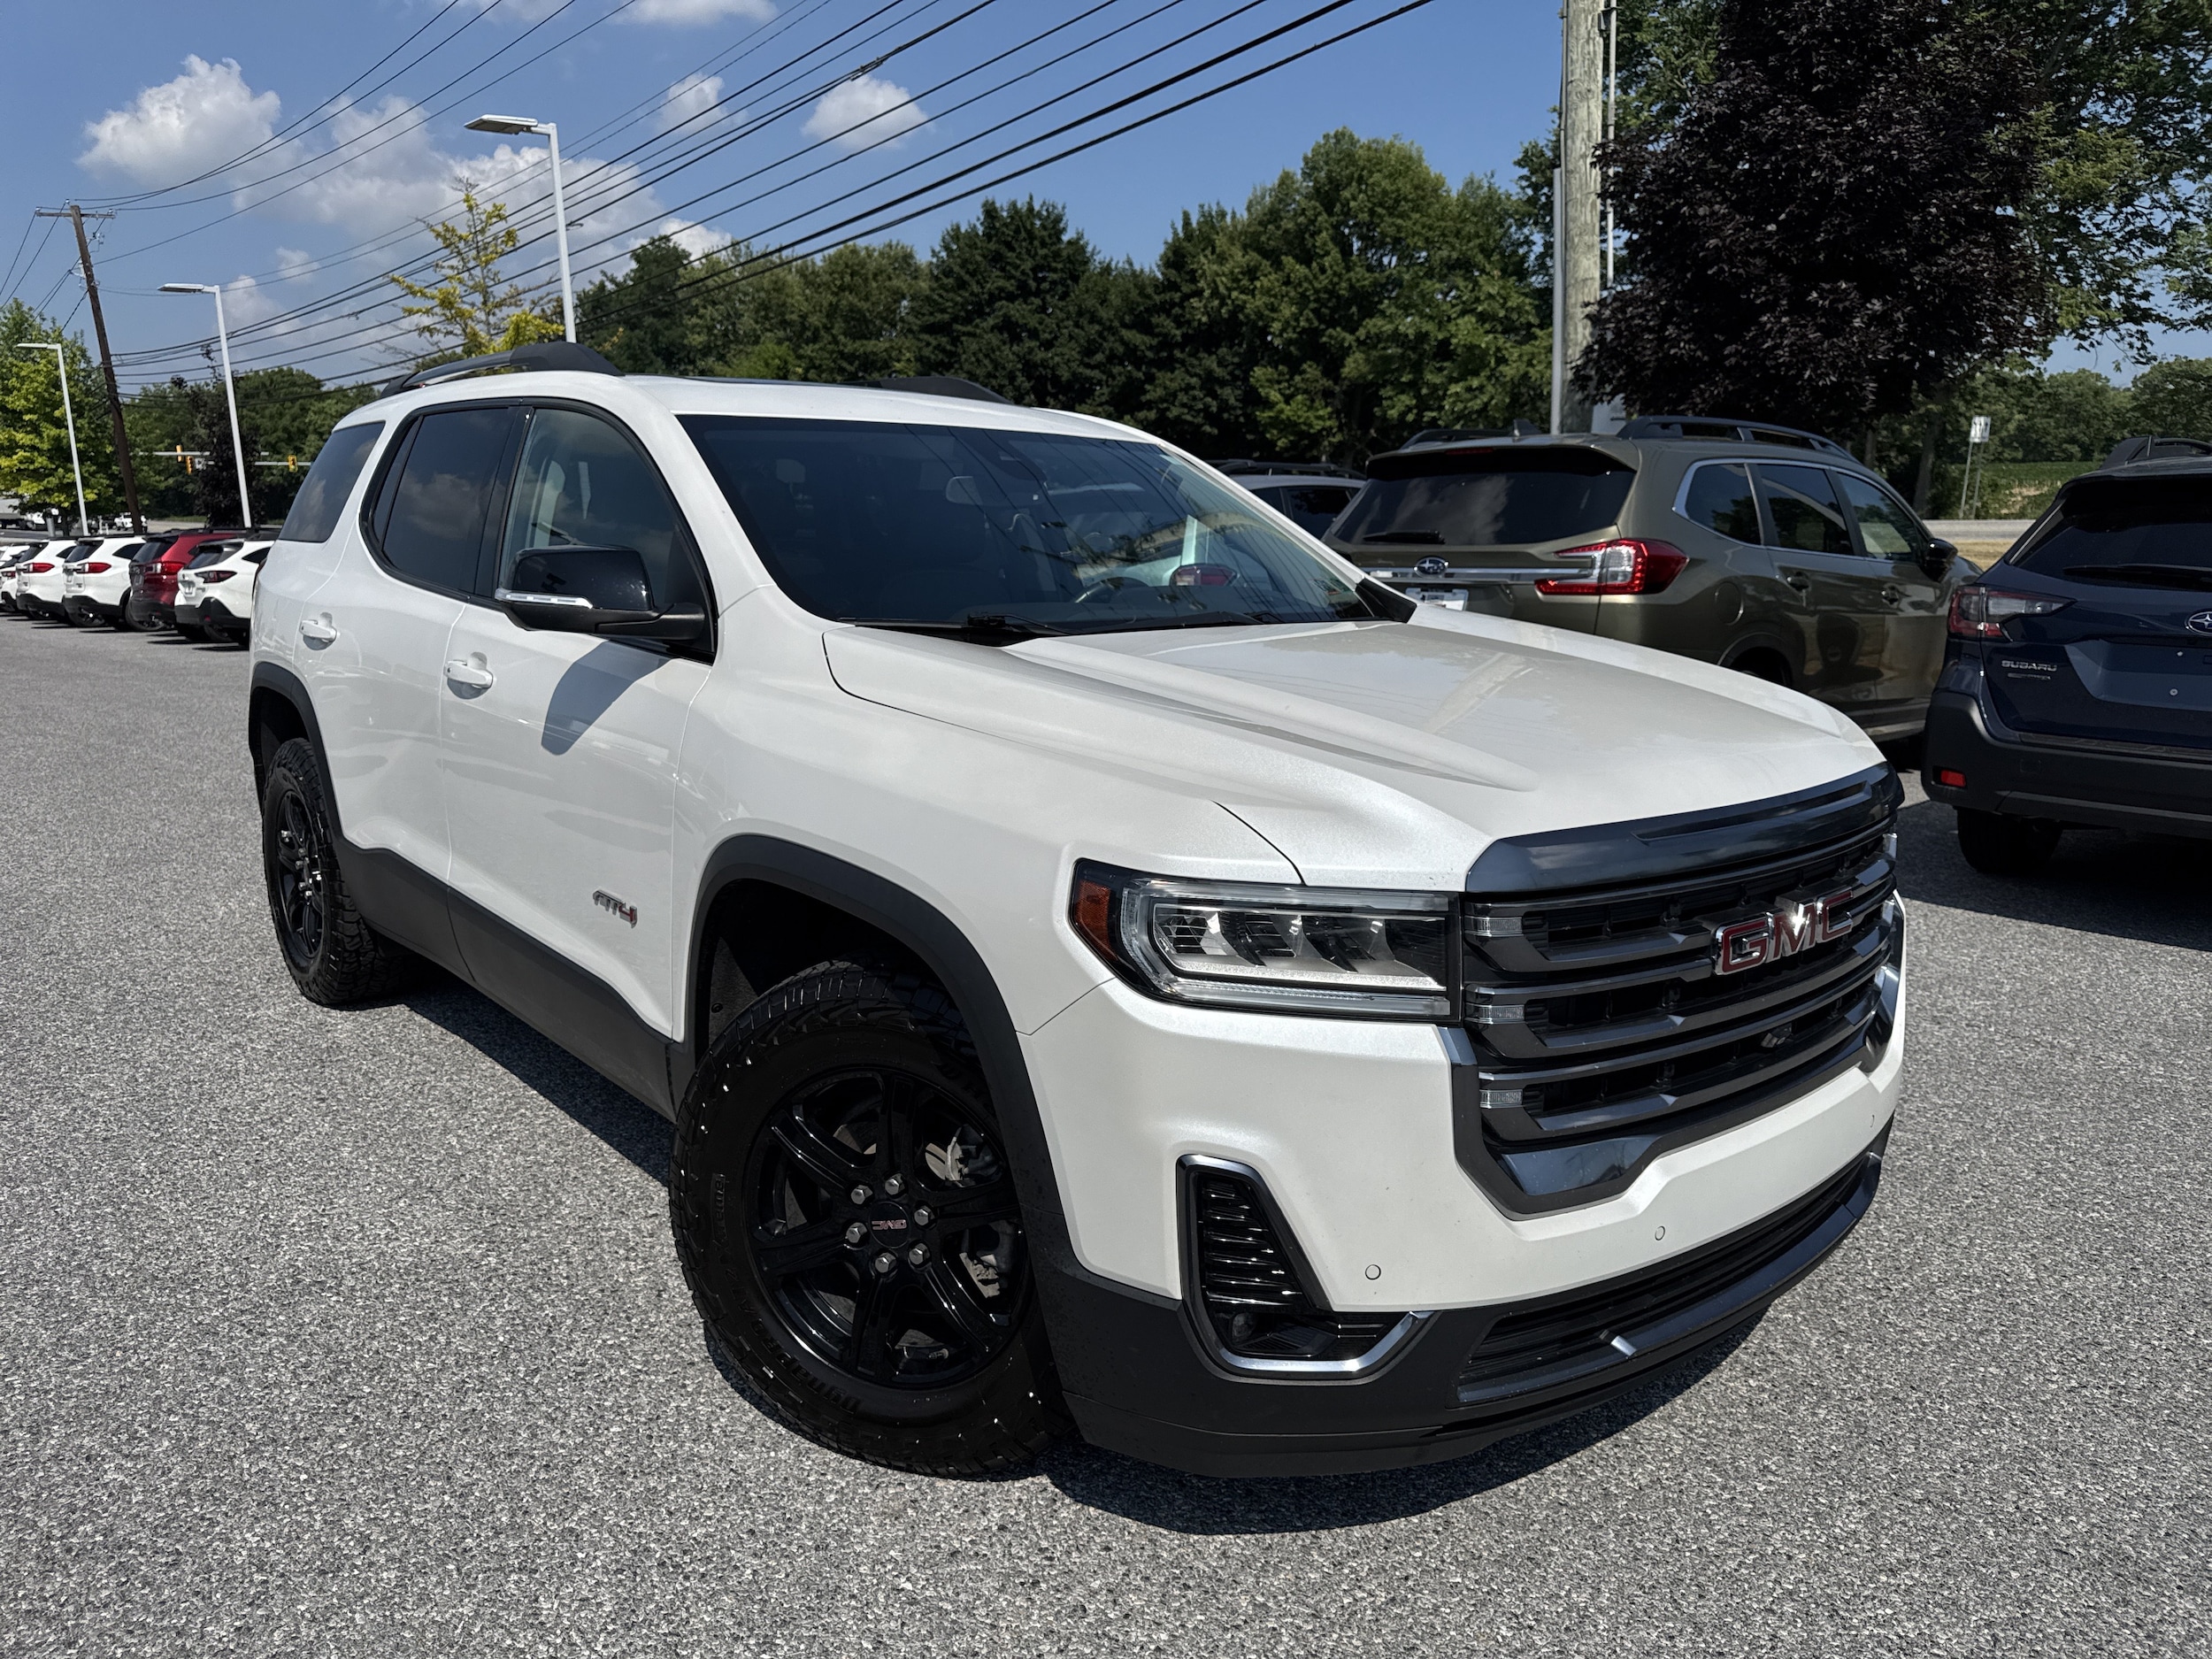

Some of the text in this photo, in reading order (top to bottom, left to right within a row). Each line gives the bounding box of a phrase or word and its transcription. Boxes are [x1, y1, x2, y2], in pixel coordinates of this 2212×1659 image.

[2001, 660, 2057, 672] SUBARU
[592, 889, 637, 929] AT4
[1714, 887, 1854, 975] GMC
[872, 1219, 907, 1231] GMC
